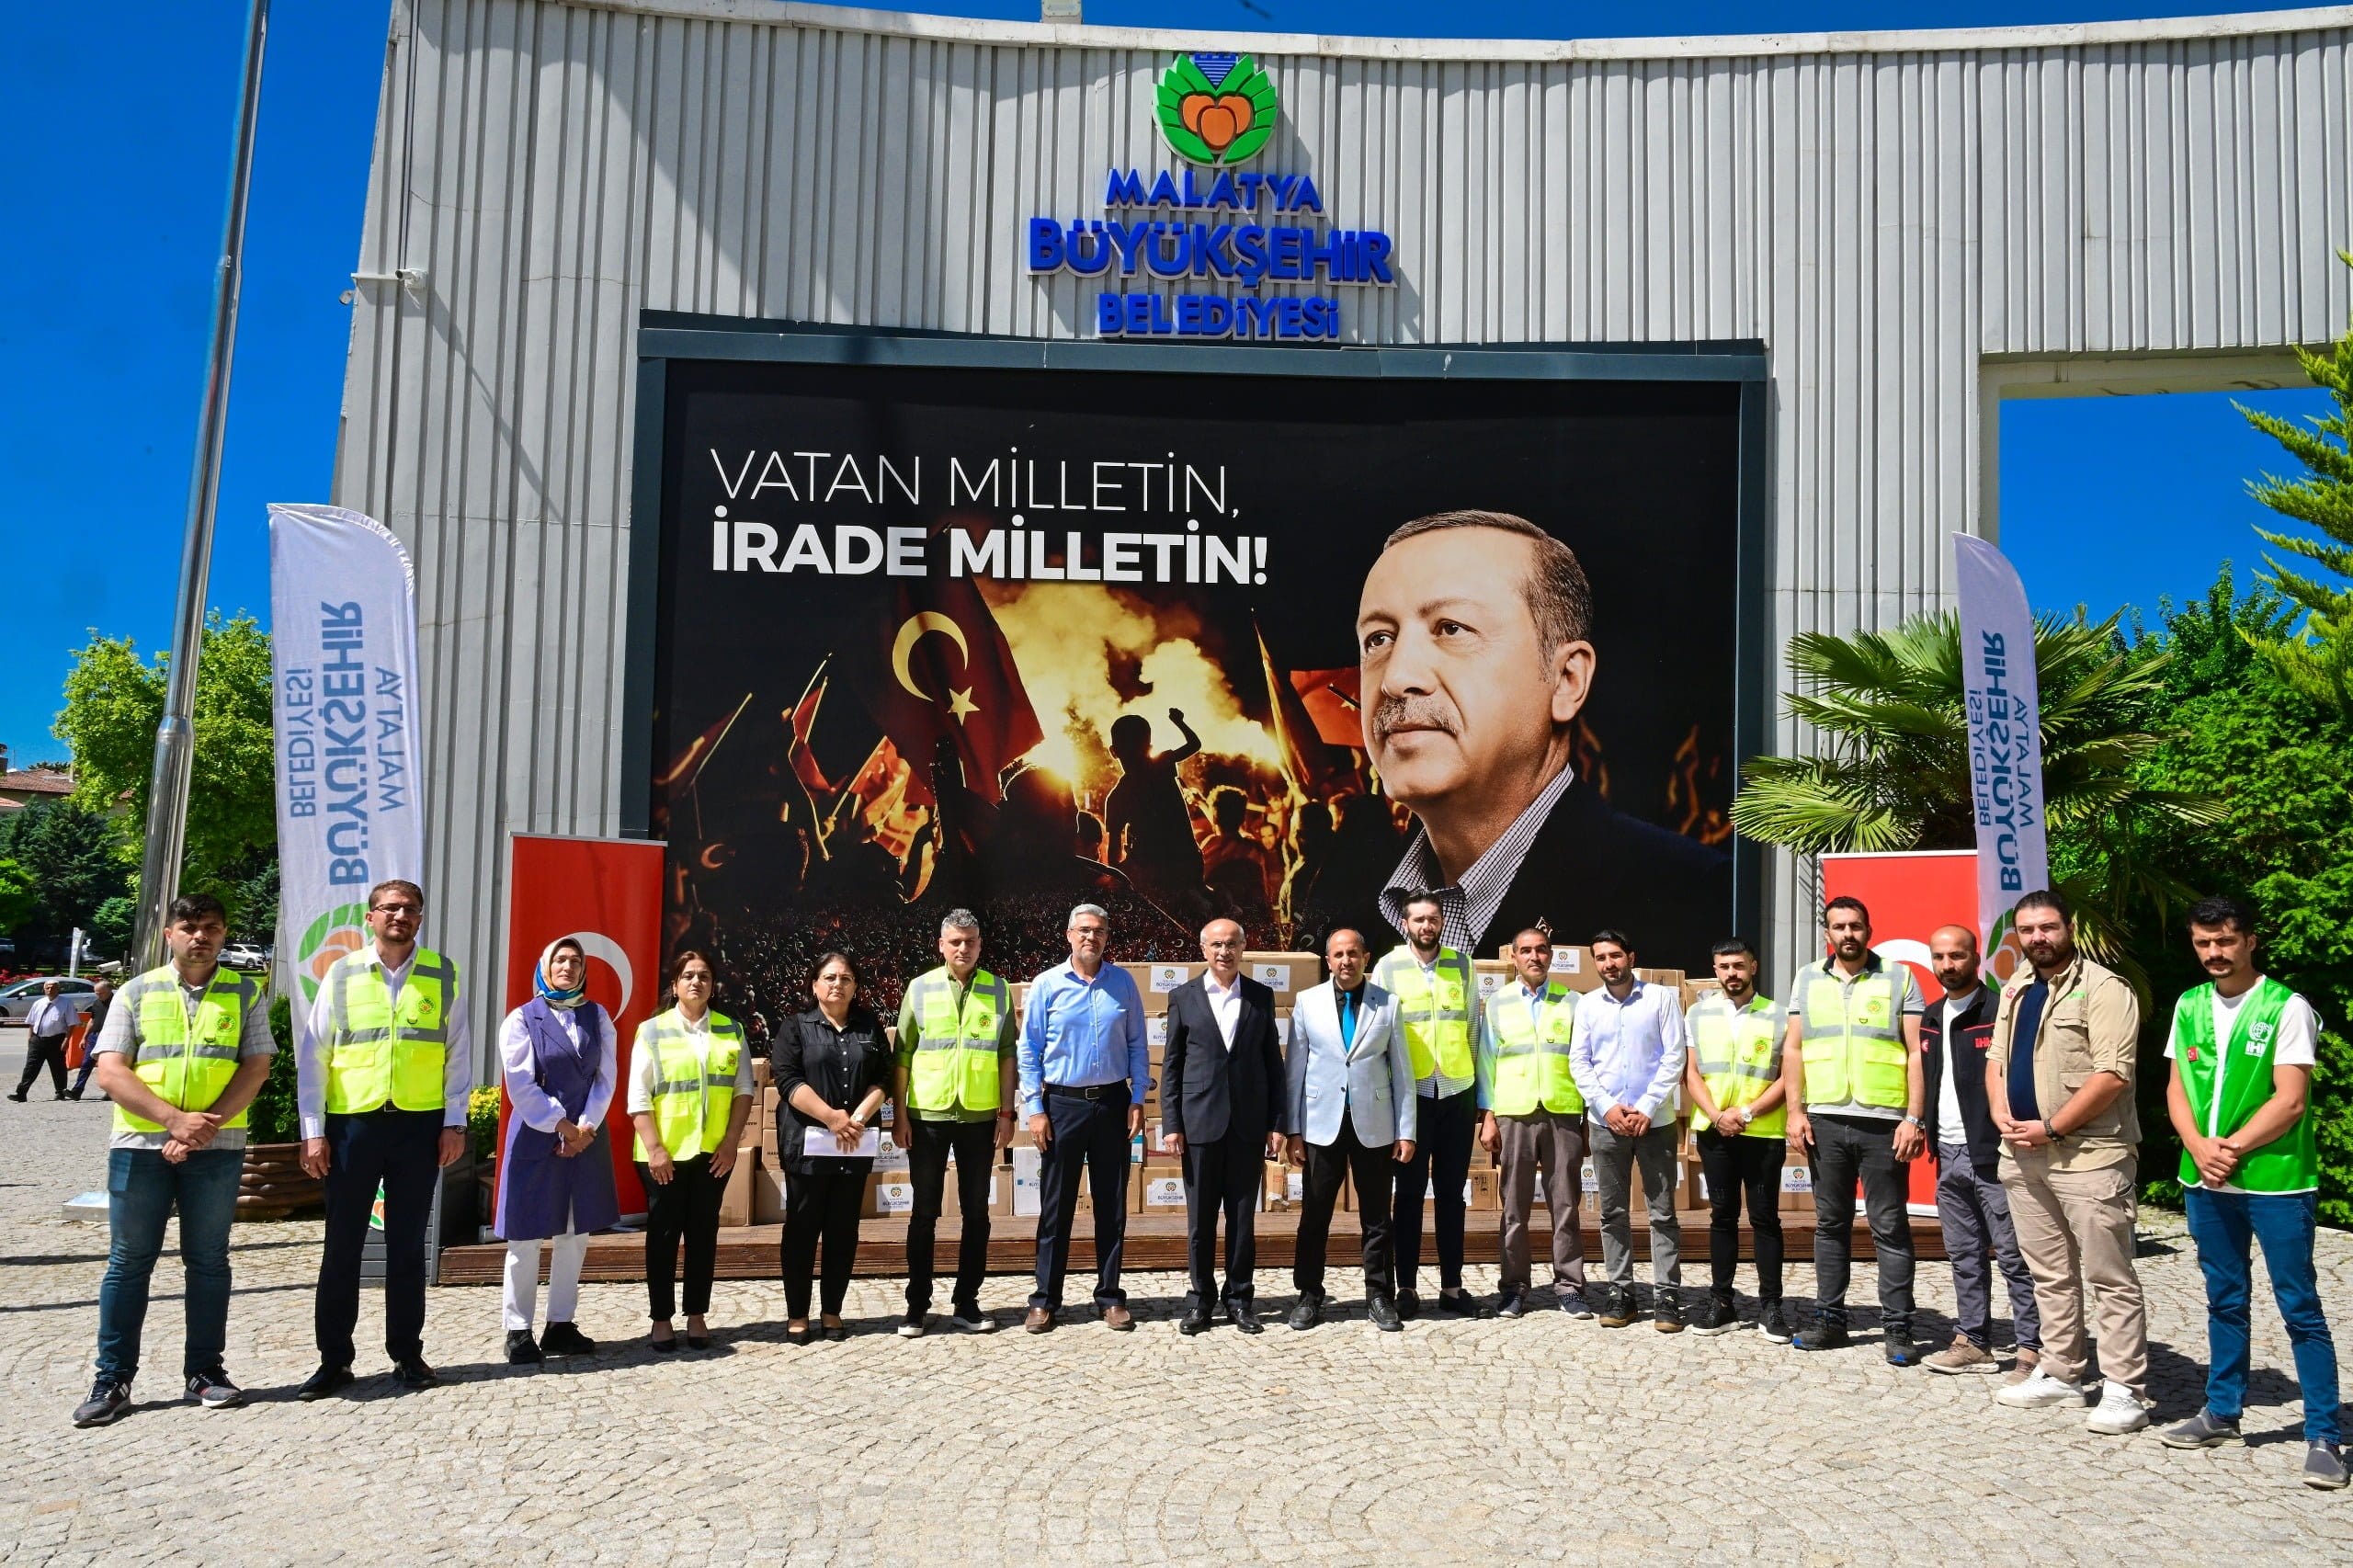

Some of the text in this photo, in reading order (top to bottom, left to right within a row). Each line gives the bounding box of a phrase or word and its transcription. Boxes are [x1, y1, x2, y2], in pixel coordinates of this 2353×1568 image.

[1106, 168, 1324, 212] MALATYA
[1029, 217, 1393, 288] BÜYÜKŞEHİR
[1098, 293, 1339, 338] BELEDİYESİ
[710, 446, 1239, 518] VATAN MİLLETİN,
[713, 505, 1268, 585] İRADE MİLLETİN!
